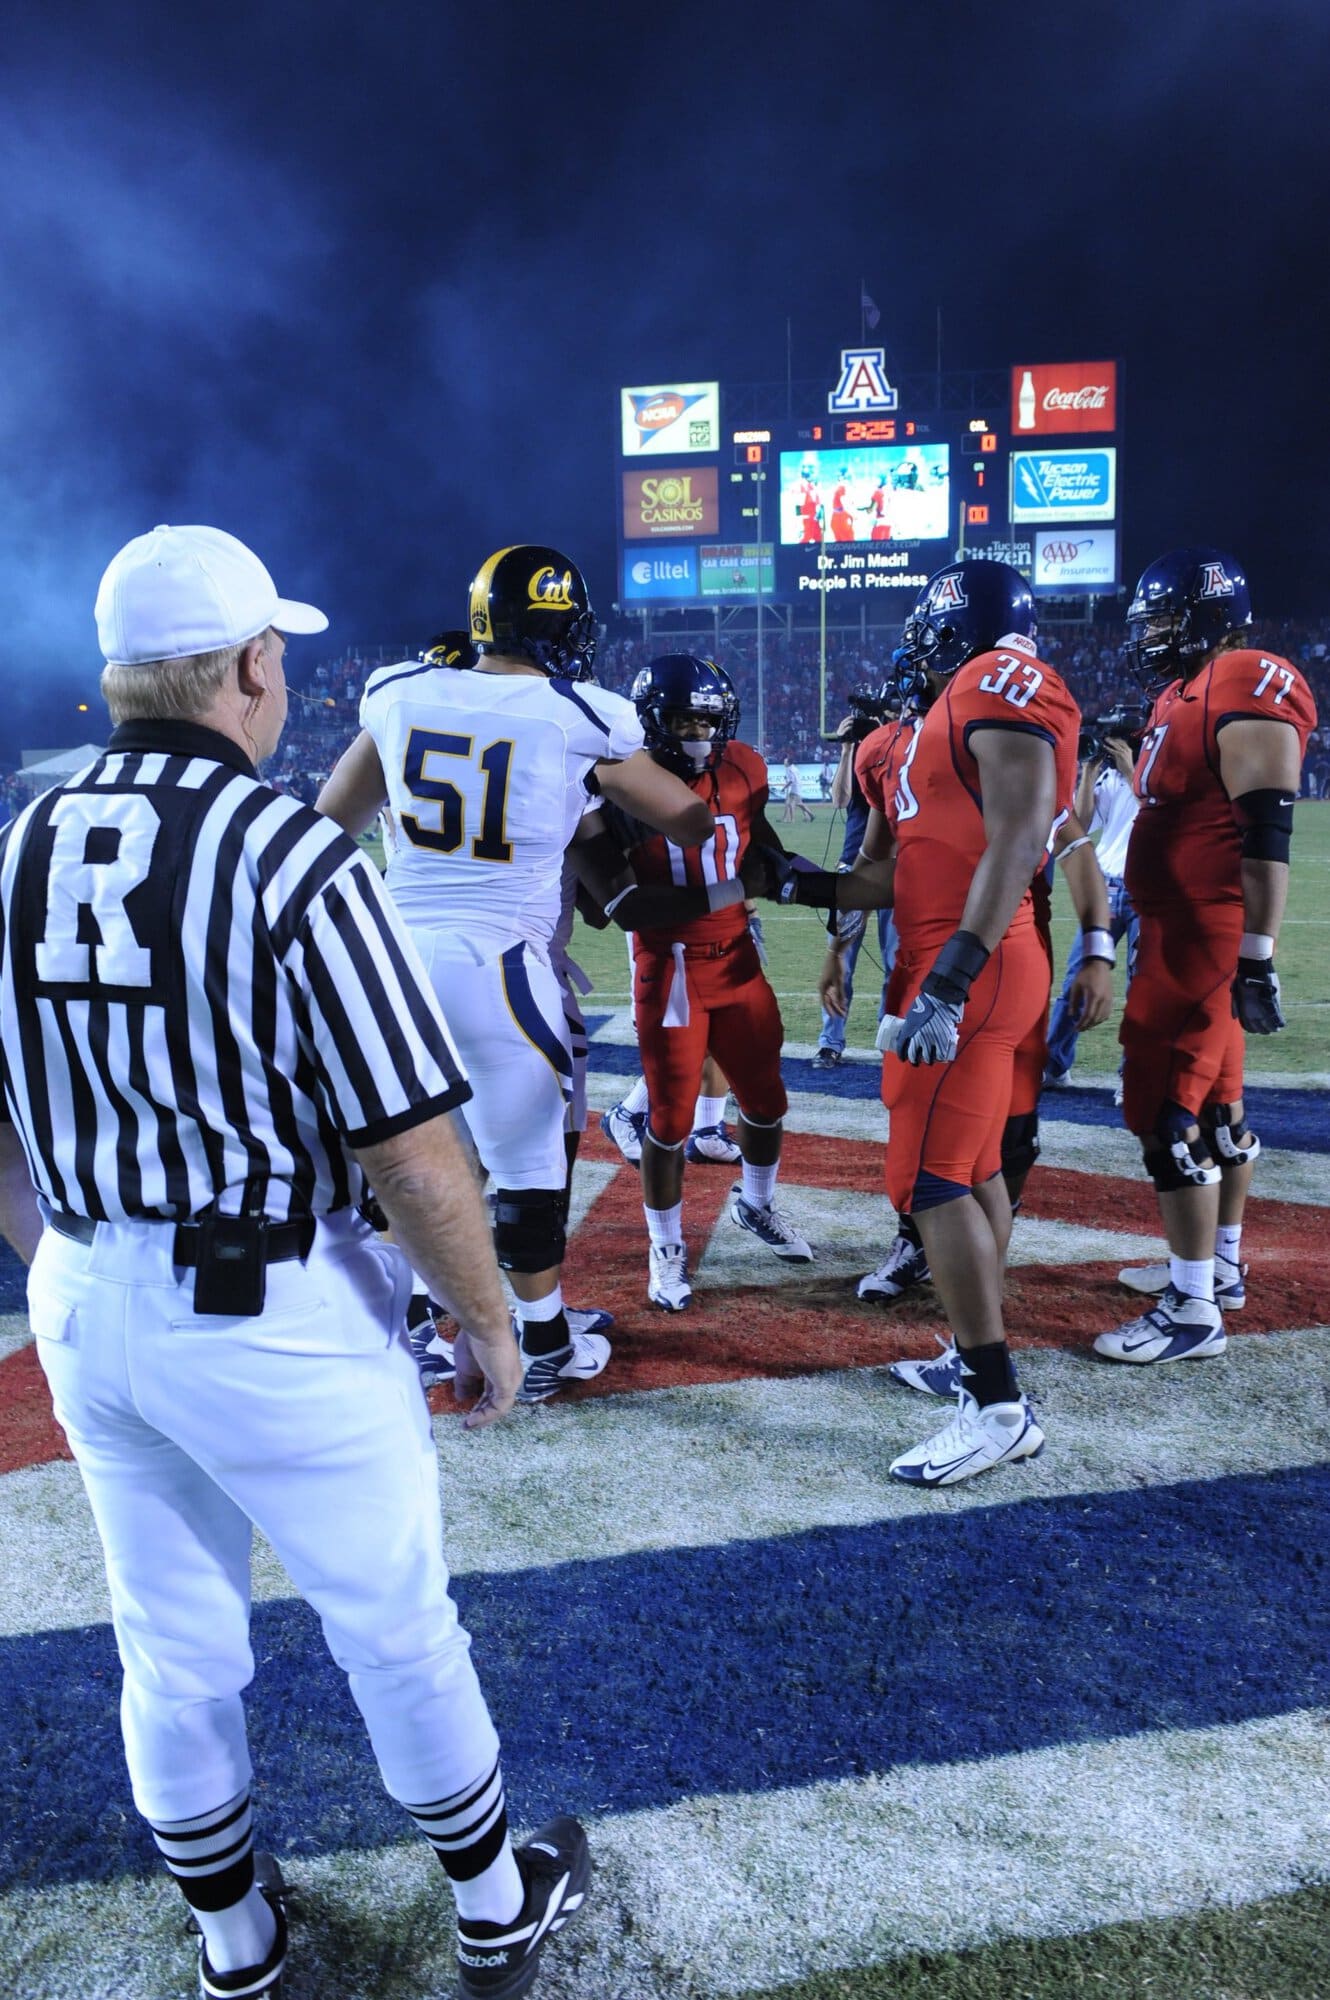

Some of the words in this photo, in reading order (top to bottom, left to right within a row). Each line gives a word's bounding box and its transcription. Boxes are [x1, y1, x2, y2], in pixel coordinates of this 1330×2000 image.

[828, 348, 898, 414] A
[1043, 386, 1109, 411] Coca-Cola
[812, 427, 822, 440] 3
[845, 420, 895, 441] 2:25
[906, 422, 915, 435] 3
[1039, 461, 1088, 475] Tucson
[1043, 475, 1100, 488] Electric
[641, 476, 703, 509] SOL
[1049, 488, 1100, 500] Power
[641, 508, 703, 523] CASINOS
[817, 555, 838, 570] Dr.
[840, 554, 865, 569] Jim
[867, 552, 909, 568] Madril
[1060, 566, 1110, 577] Insurance
[528, 566, 573, 611] Cal
[799, 575, 847, 592] People
[850, 574, 862, 588] R
[865, 571, 928, 588] Priceless
[1200, 561, 1234, 599] A
[979, 654, 1043, 708] 33
[1253, 657, 1295, 705] 77
[400, 726, 516, 864] 51
[35, 793, 161, 988] R
